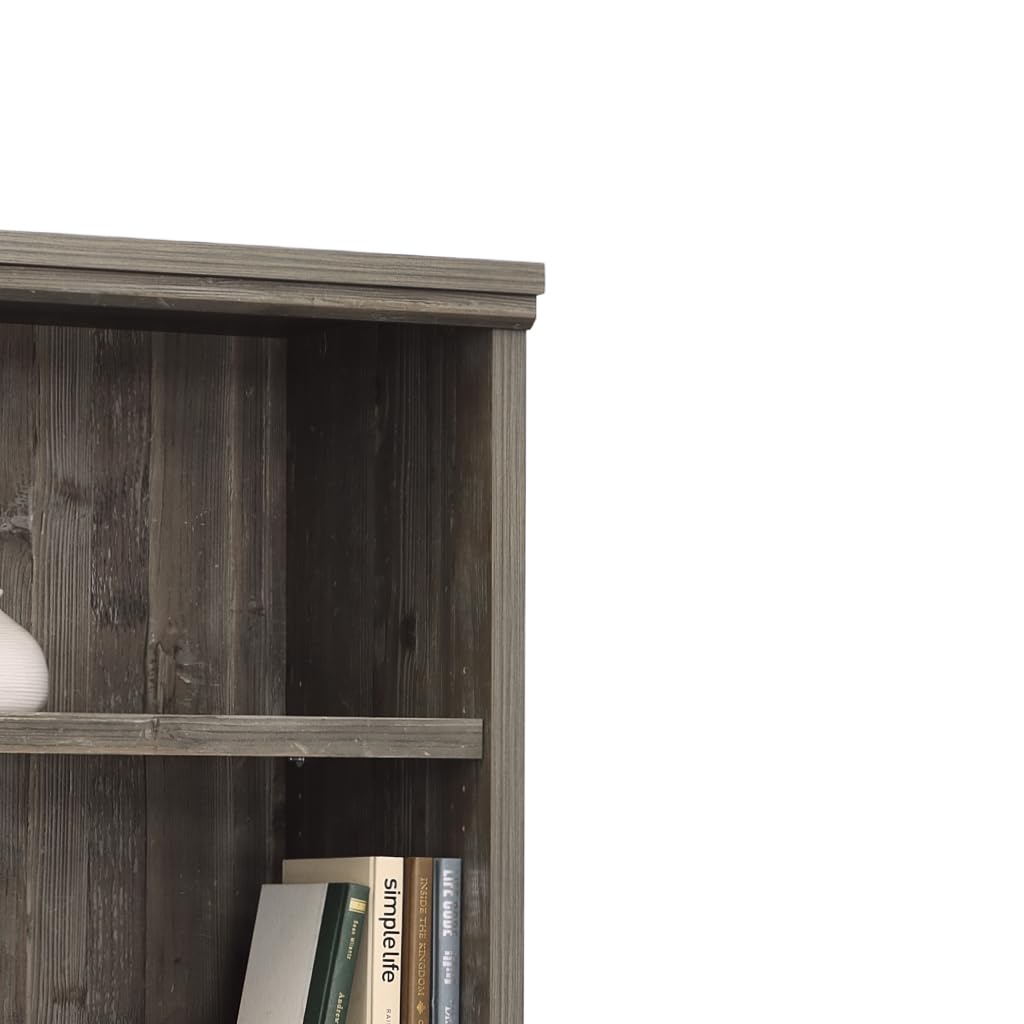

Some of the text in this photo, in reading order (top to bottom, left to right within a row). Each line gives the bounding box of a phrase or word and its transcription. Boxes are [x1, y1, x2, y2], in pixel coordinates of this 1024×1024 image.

[378, 878, 400, 982] simple life
[417, 877, 428, 996] INSIDE THE KINGDOM
[334, 991, 345, 1024] Andrew
